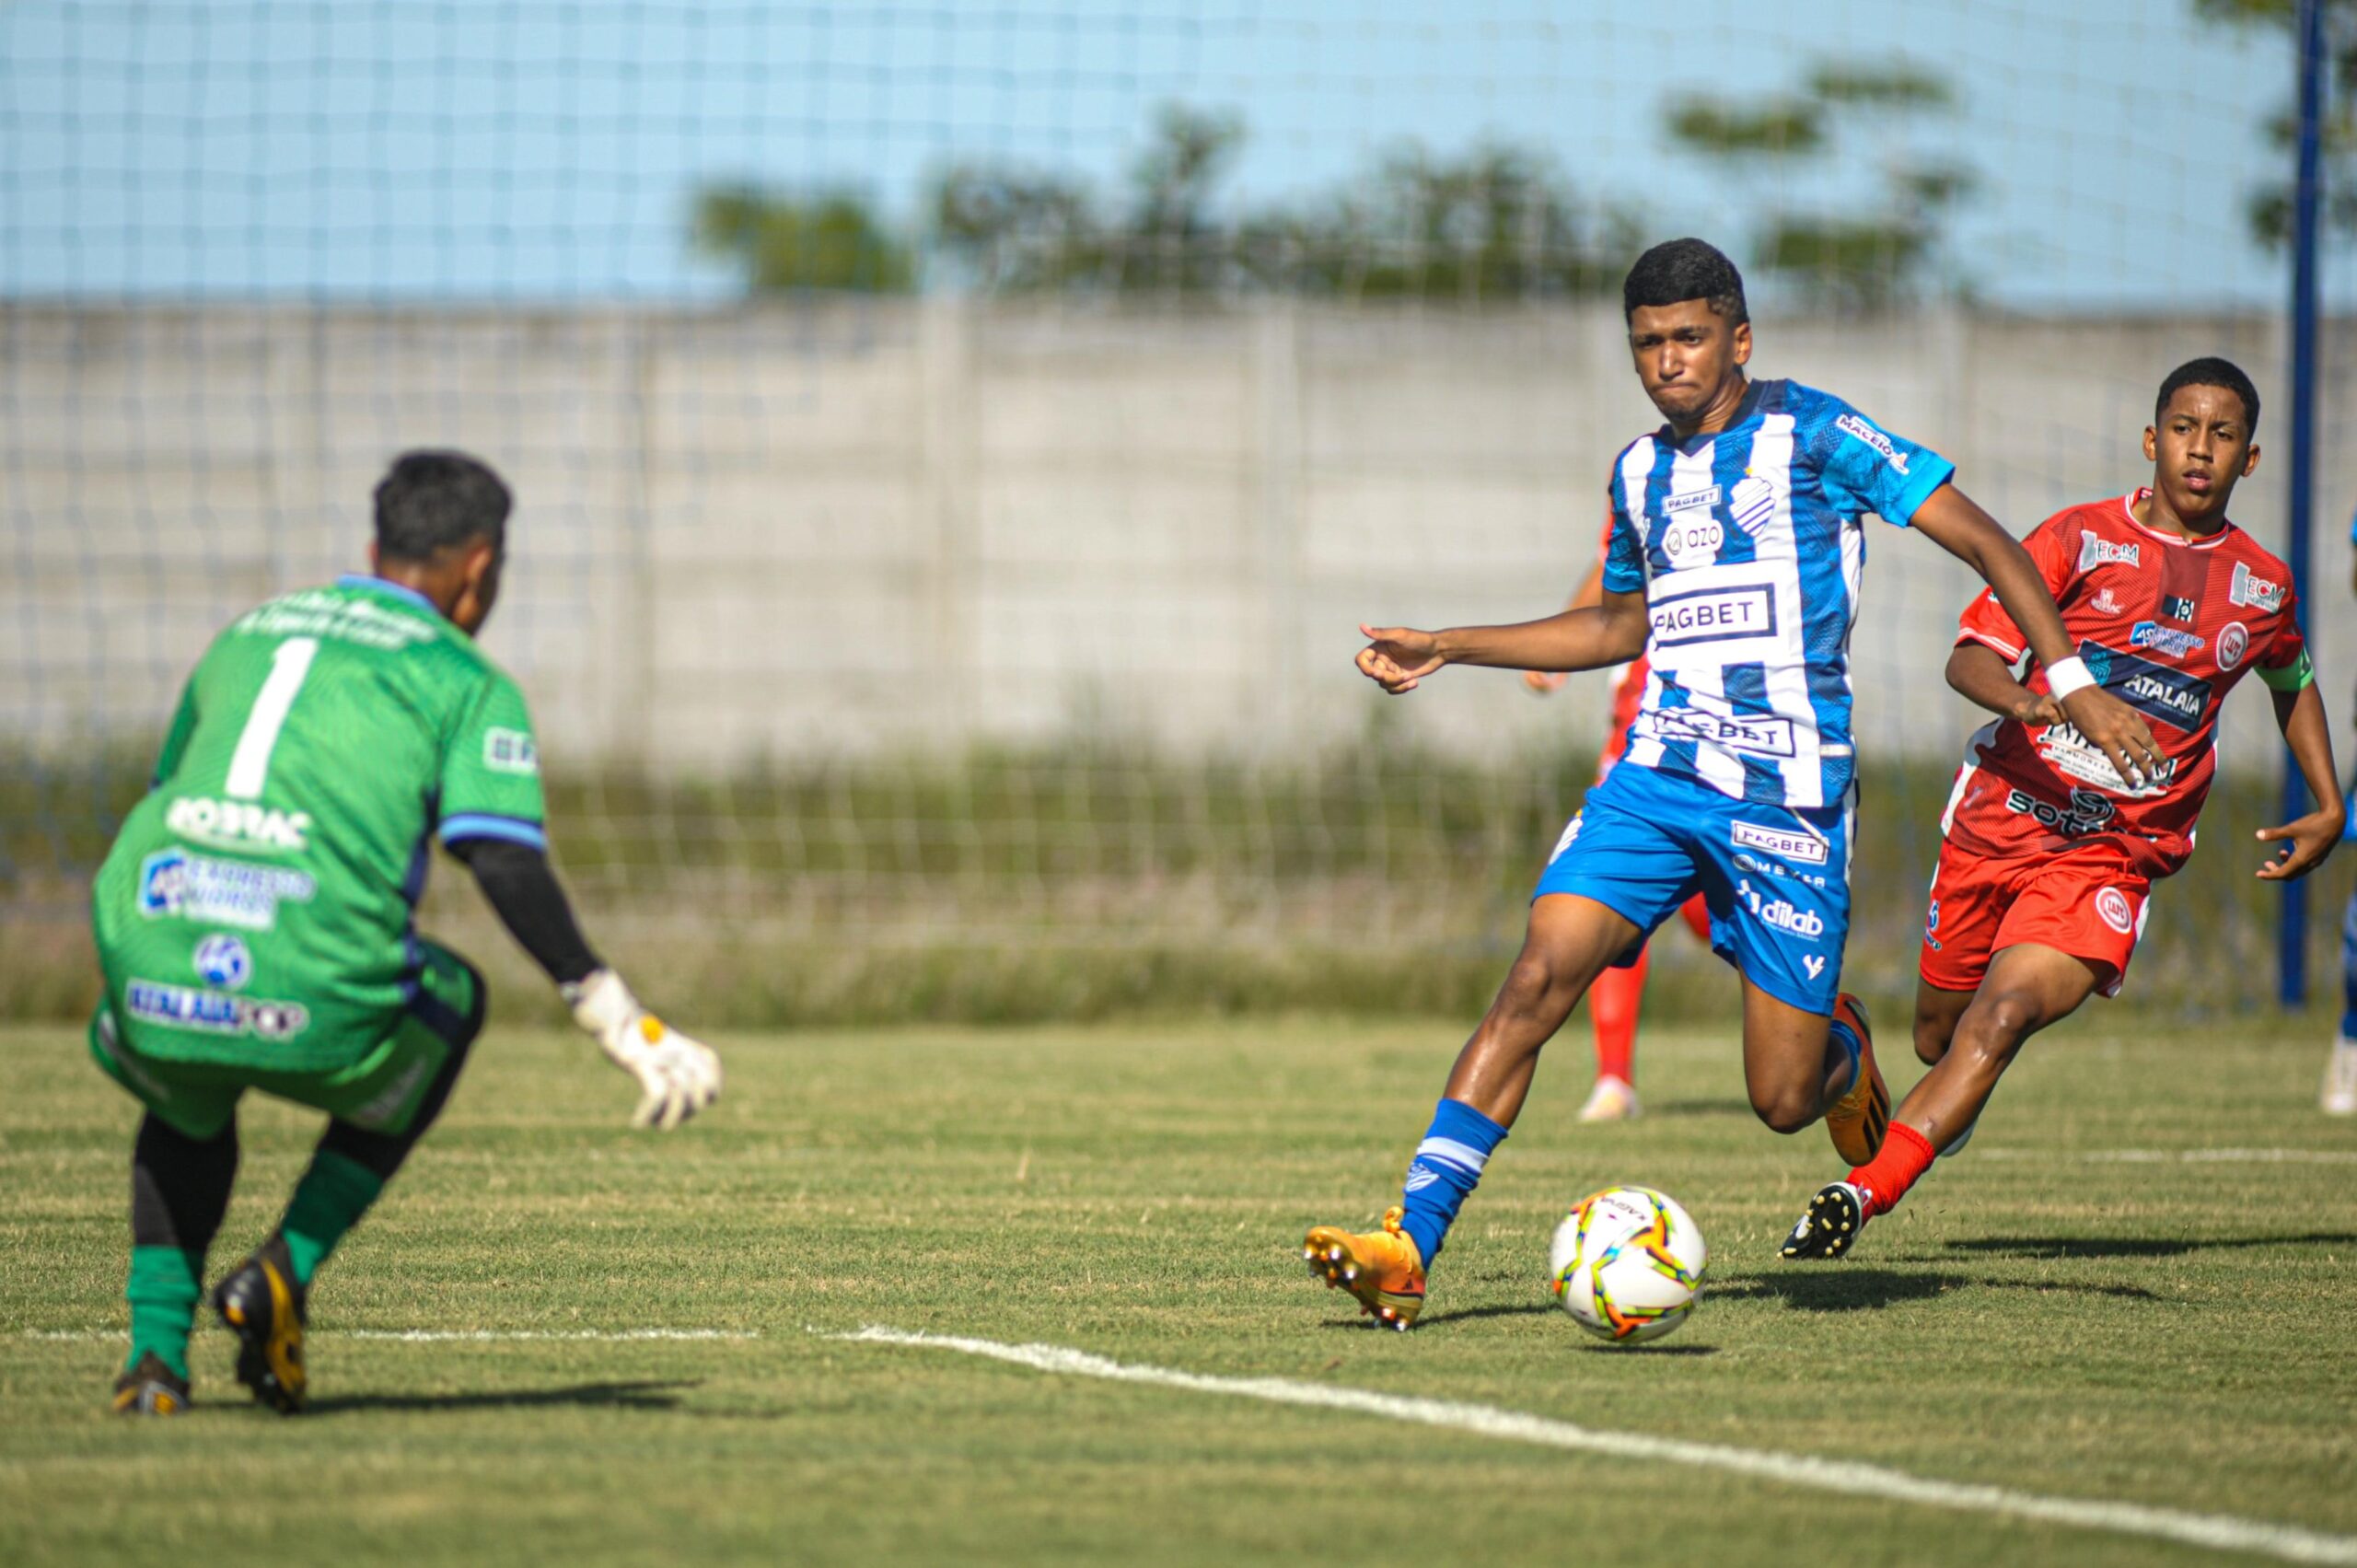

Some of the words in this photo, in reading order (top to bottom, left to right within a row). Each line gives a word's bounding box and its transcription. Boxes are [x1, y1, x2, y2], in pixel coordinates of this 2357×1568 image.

[1668, 492, 1714, 508] PAGBET
[2247, 577, 2284, 602] ECM
[1655, 601, 1753, 633] PAGBET
[2124, 674, 2200, 716] ATALAIA
[224, 637, 320, 798] 1
[1744, 830, 1817, 854] PAGBET
[1761, 900, 1824, 936] dilab
